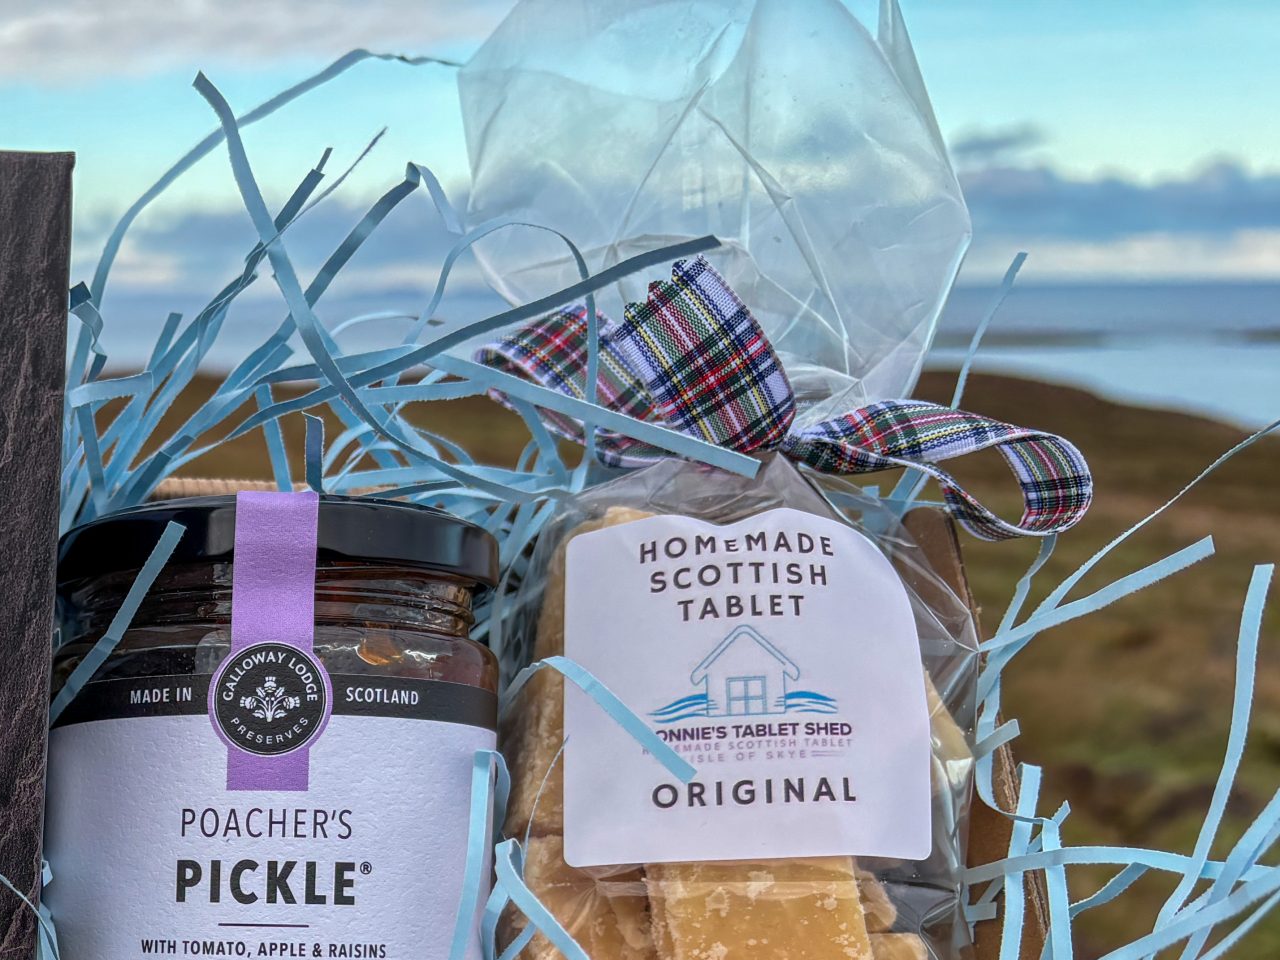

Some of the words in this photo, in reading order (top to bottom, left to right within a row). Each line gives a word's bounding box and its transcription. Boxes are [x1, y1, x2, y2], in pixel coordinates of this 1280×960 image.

[639, 531, 835, 565] HOMEMADE
[649, 563, 828, 593] SCOTTISH
[677, 594, 806, 622] TABLET
[222, 651, 287, 702] GALLOWAY
[287, 657, 319, 702] LODGE
[129, 688, 171, 706] MADE
[174, 687, 193, 704] IN
[345, 687, 420, 706] SCOTLAND
[230, 716, 309, 745] PRESERVES
[728, 739, 798, 751] SCOTTISH
[804, 737, 854, 748] TABLET
[731, 723, 799, 738] TABLET
[804, 722, 853, 737] SHED
[735, 751, 756, 762] OF
[766, 749, 807, 761] SKYE
[651, 776, 857, 809] ORIGINAL
[180, 807, 354, 841] POACHER'S
[140, 938, 178, 956] WITH
[182, 939, 253, 959] TOMATO,
[257, 941, 307, 959] APPLE
[311, 941, 325, 959] &
[328, 941, 387, 960] RAISINS
